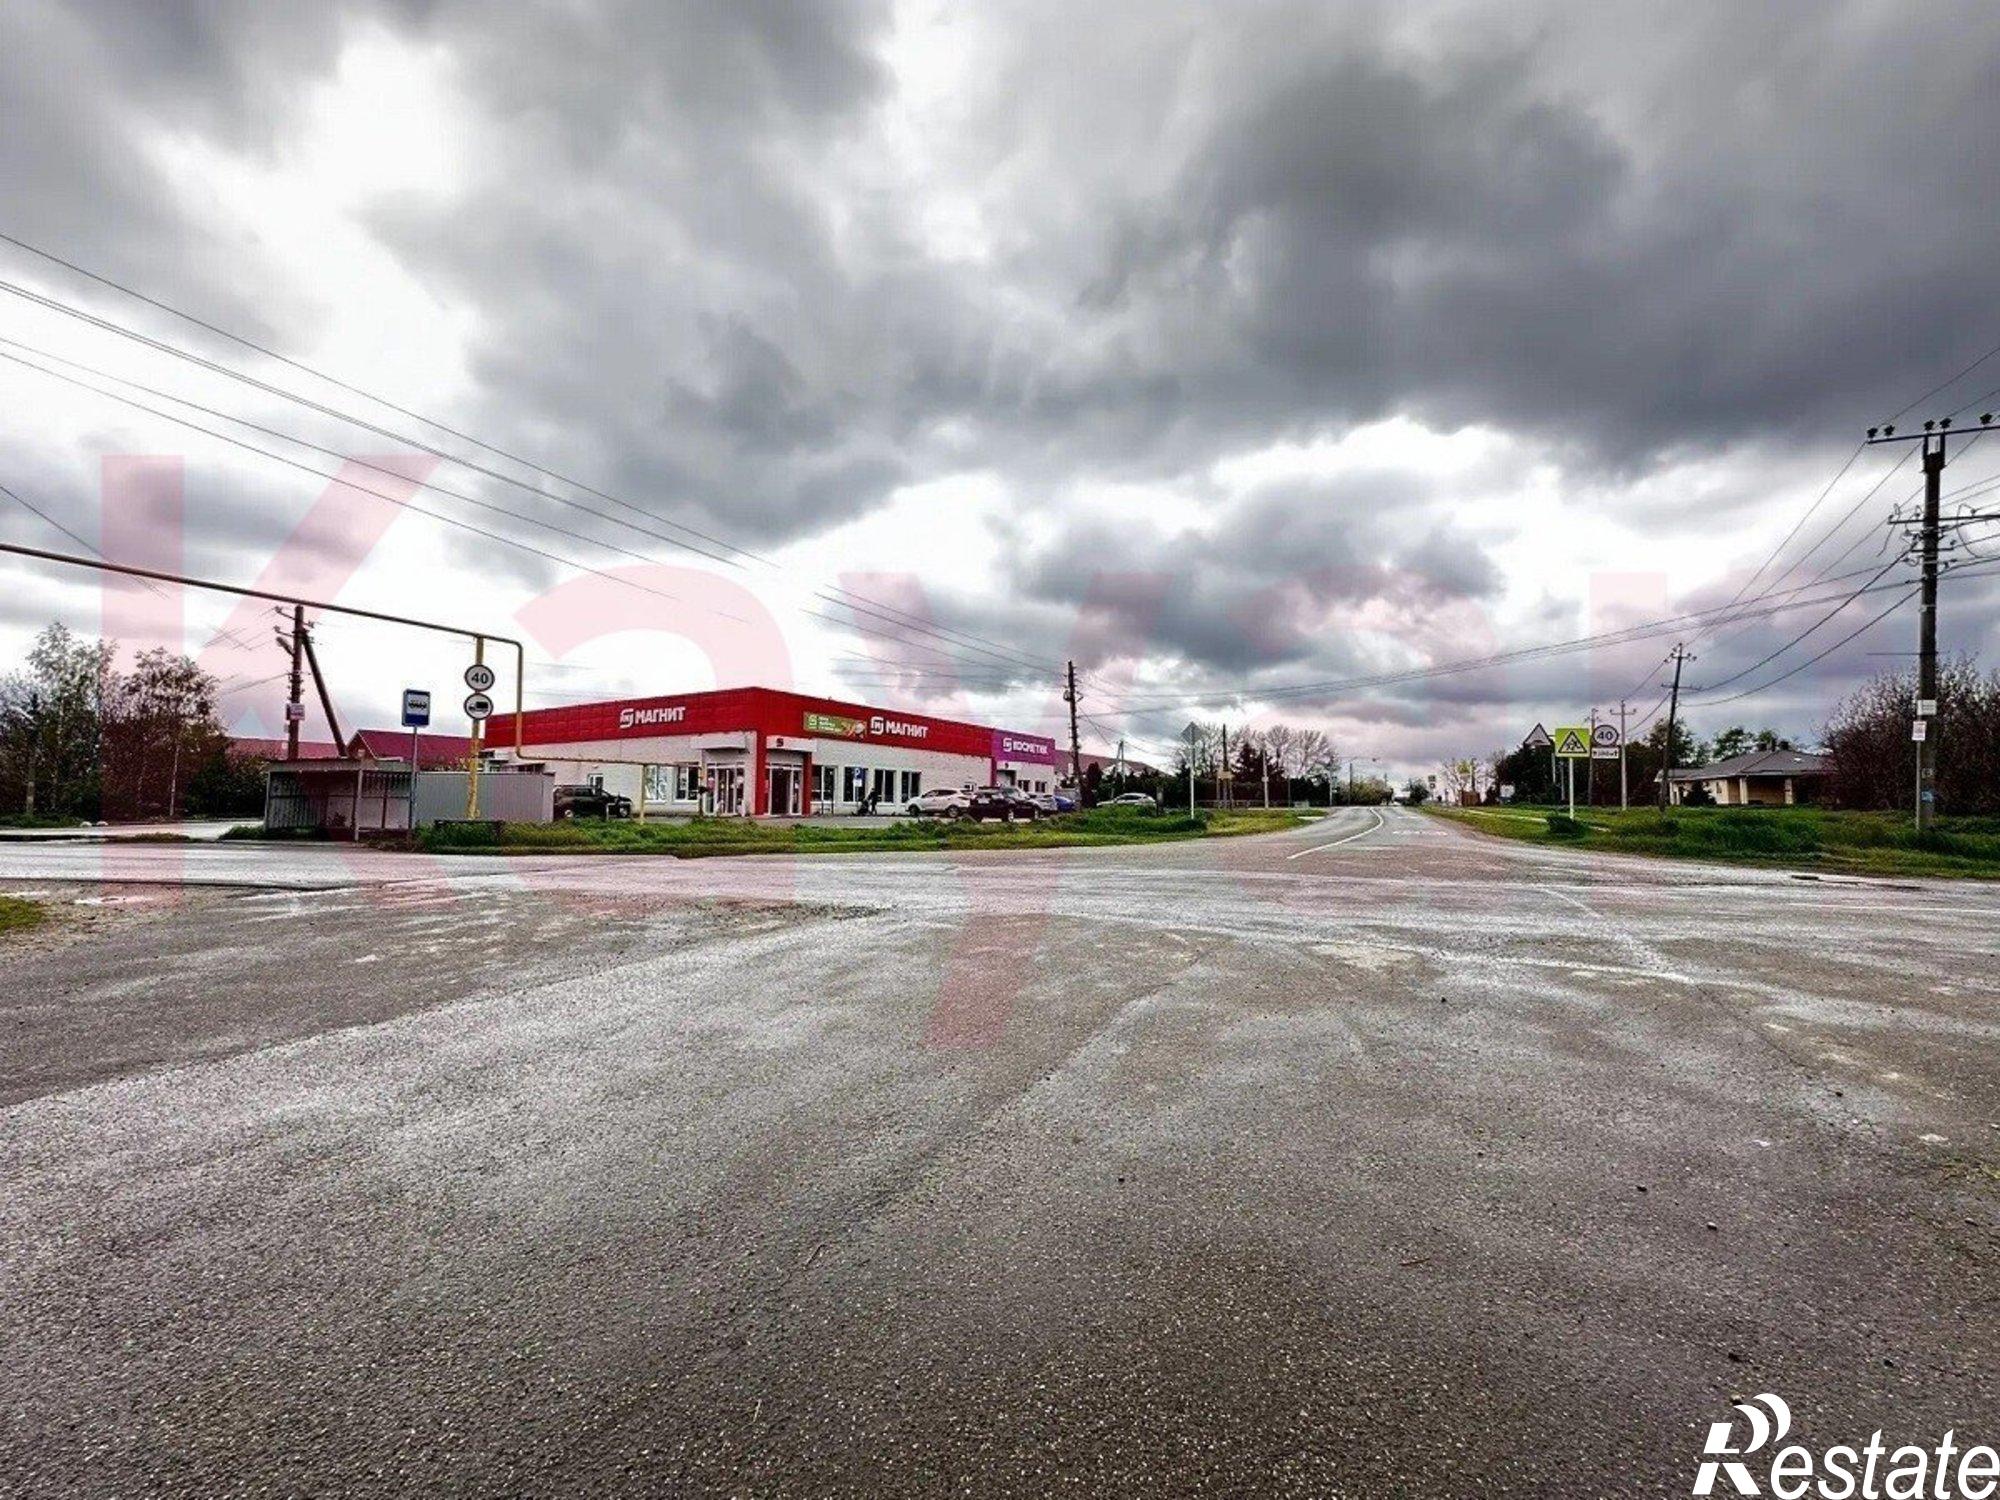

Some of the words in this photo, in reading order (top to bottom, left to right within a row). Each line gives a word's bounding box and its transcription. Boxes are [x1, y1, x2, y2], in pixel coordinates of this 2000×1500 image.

[471, 672, 489, 684] 40
[635, 706, 686, 724] МАГНИТ
[886, 720, 928, 738] МАГНИТ
[1596, 731, 1614, 741] 40
